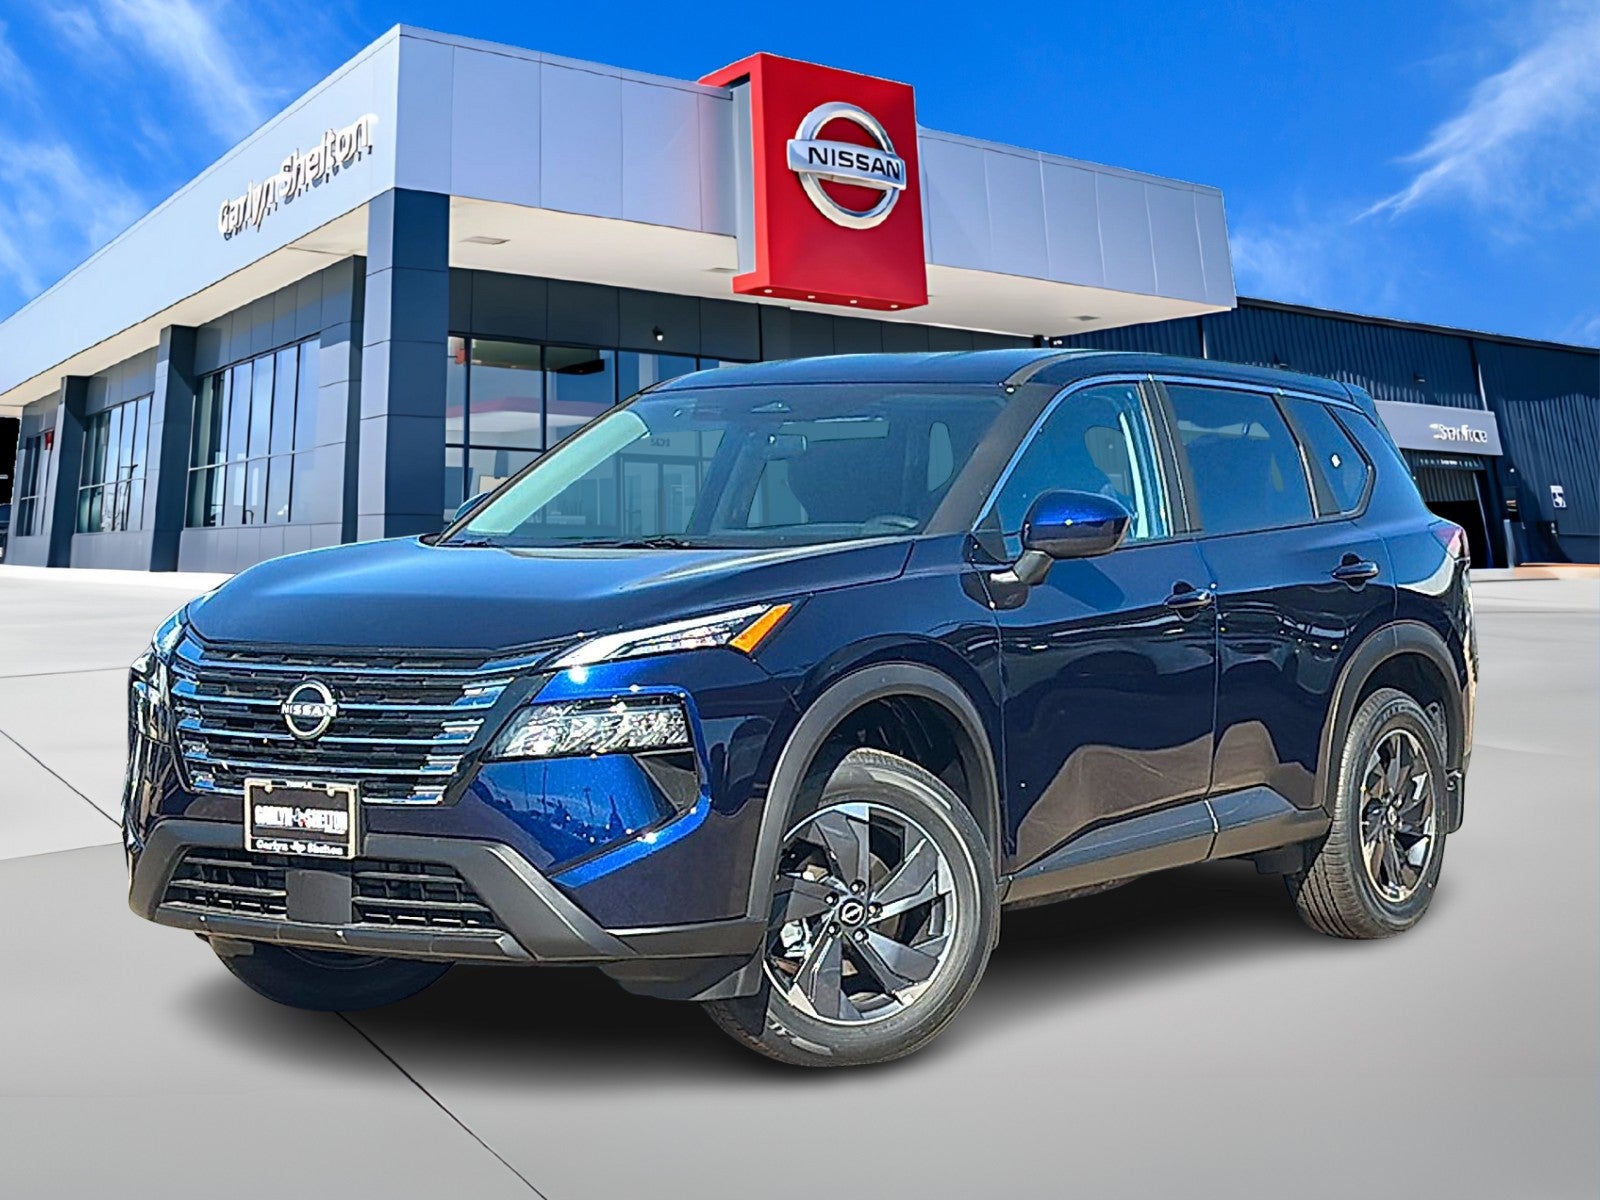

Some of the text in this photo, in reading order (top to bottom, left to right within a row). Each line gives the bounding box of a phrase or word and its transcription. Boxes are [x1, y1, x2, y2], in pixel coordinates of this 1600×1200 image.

[277, 114, 375, 204] Shelton
[808, 147, 900, 180] NISSAN
[281, 703, 337, 717] NISSAN
